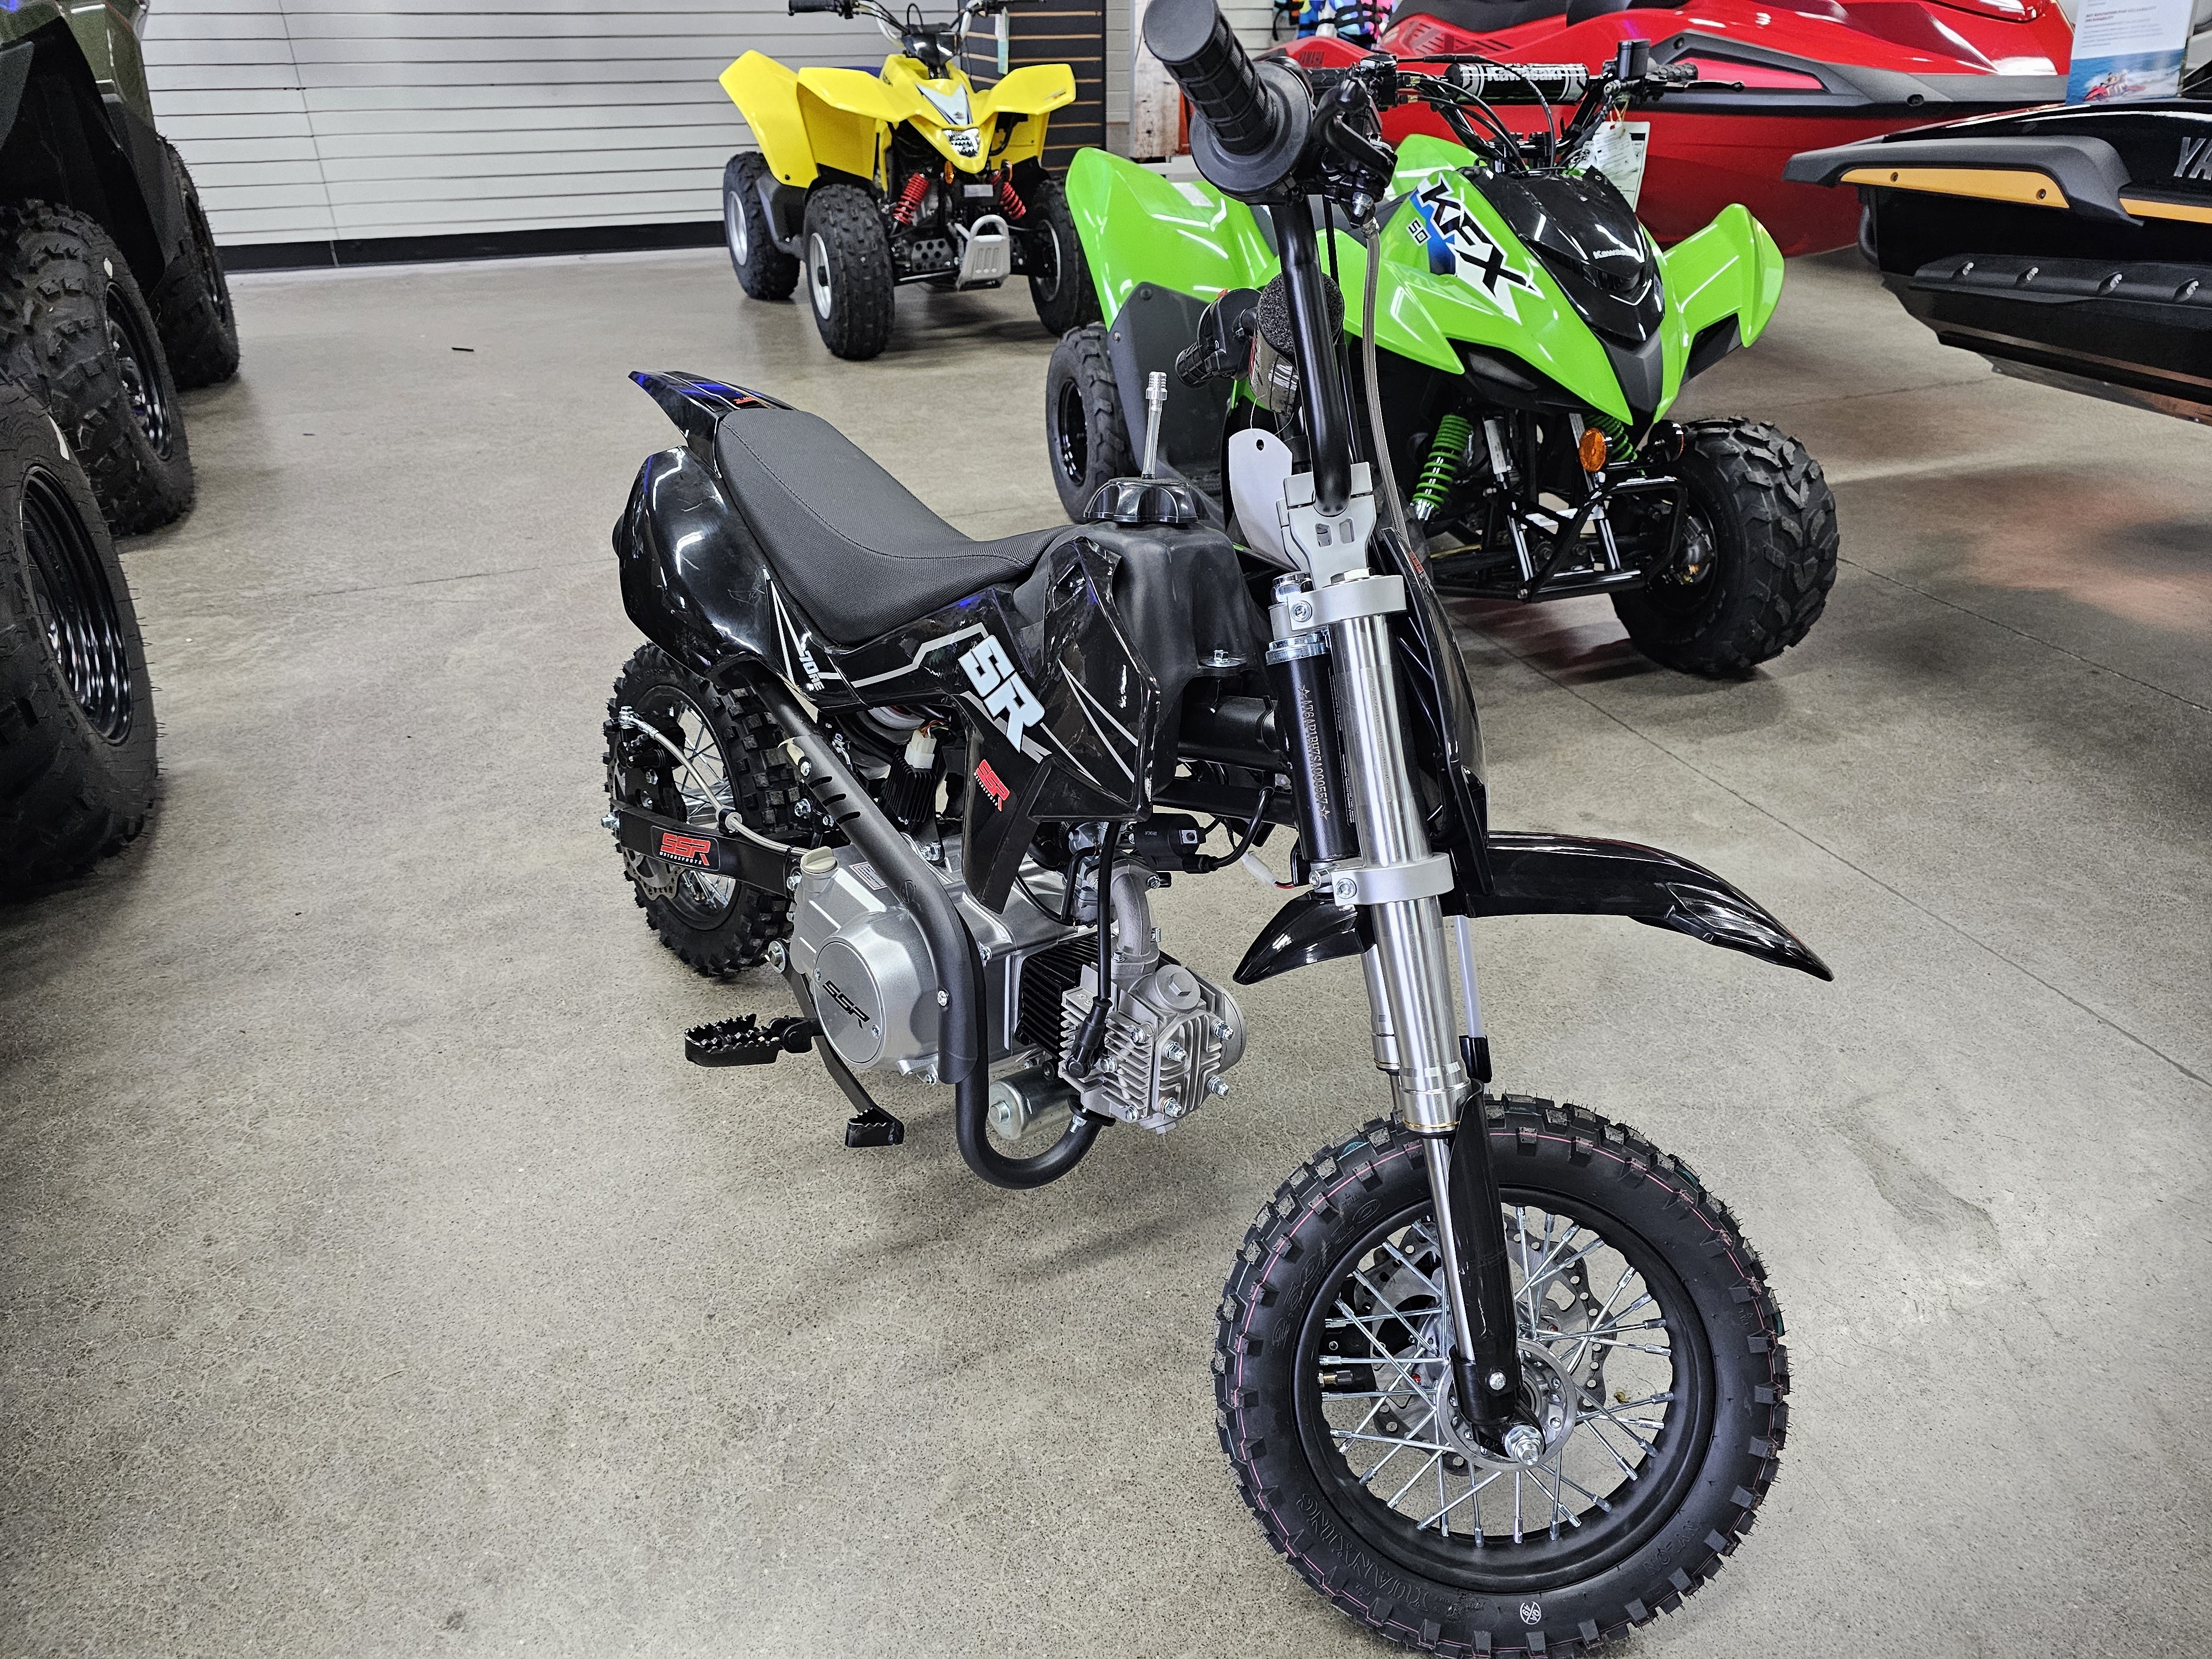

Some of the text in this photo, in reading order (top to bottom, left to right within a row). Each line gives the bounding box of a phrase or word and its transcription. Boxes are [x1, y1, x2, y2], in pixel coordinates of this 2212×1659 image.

[1408, 219, 1430, 244] 50
[1418, 176, 1542, 302] KFX
[1593, 248, 1638, 259] Kawas
[958, 634, 1045, 754] SR
[975, 759, 1010, 811] SSR
[660, 832, 711, 866] SSR
[822, 980, 870, 1029] SSR
